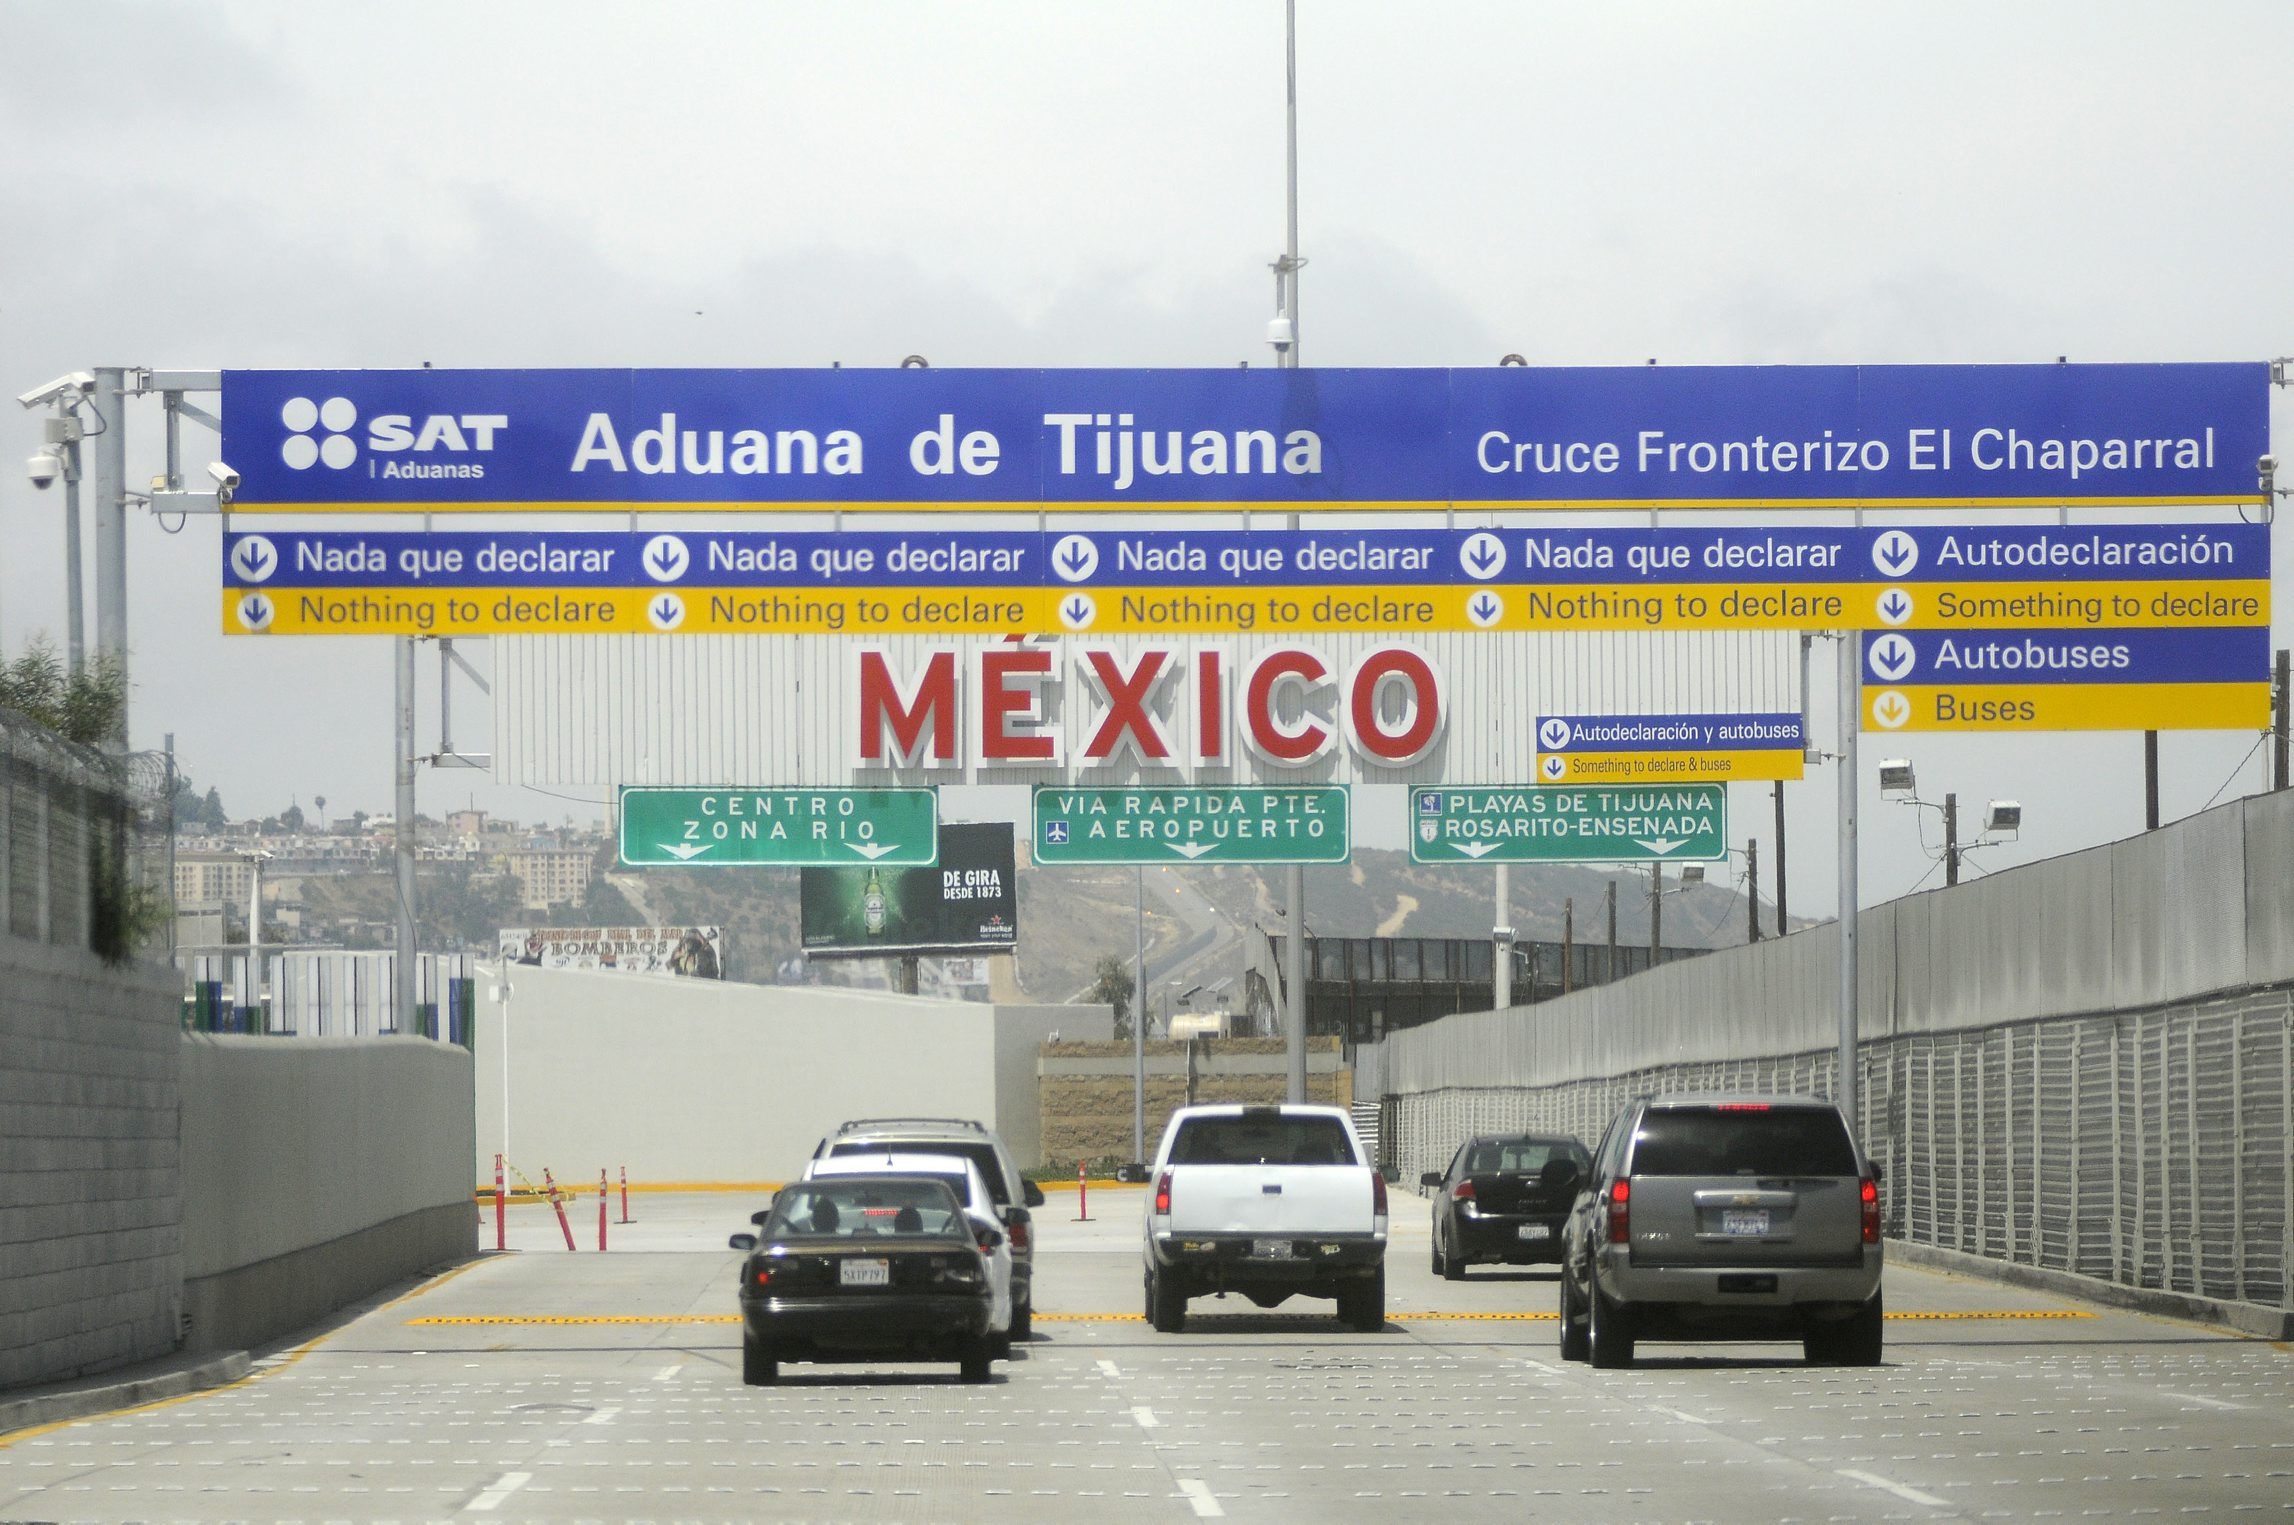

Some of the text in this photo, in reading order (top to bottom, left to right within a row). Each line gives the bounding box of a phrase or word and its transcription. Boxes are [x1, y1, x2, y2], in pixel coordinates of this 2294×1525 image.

[369, 415, 507, 451] SAT
[571, 413, 1321, 489] Aduana de Tijuana
[1478, 428, 2213, 479] Cruce Fronterizo El Chaparral
[383, 461, 484, 478] Aduanas
[298, 542, 615, 578] Nada que declarar
[709, 541, 1024, 578] Nada que declarar
[1119, 540, 1433, 577] Nada que declarar
[1527, 538, 1841, 574] Nada que declarar
[1937, 535, 2232, 565] Autodeclaración
[299, 595, 615, 629] Nothing to declare
[712, 595, 1023, 629] Nothing to declare
[1122, 595, 1433, 629] Nothing to declare
[1530, 589, 1841, 624] Nothing to declare
[1936, 591, 2260, 624] Something to declare
[1935, 639, 2129, 669] Autobuses
[1937, 694, 2035, 721] Buses
[1573, 722, 1799, 743] Autodeclaración y autobuses
[1573, 757, 1731, 776] Something to declare & buses
[702, 797, 853, 815] CENTRO
[1059, 796, 1325, 814] VIA RAPIDA PTE.
[1451, 793, 1713, 813] PLAYAS DE TIJUANA
[684, 821, 875, 840] ZONA RIO
[1089, 819, 1323, 838] AEROPUERTO
[1446, 817, 1713, 837] ROSARITO-ENSENADA
[944, 870, 1000, 887] DE GIRA
[944, 886, 1001, 899] DESDE 1873
[552, 941, 668, 955] BOMBEROS
